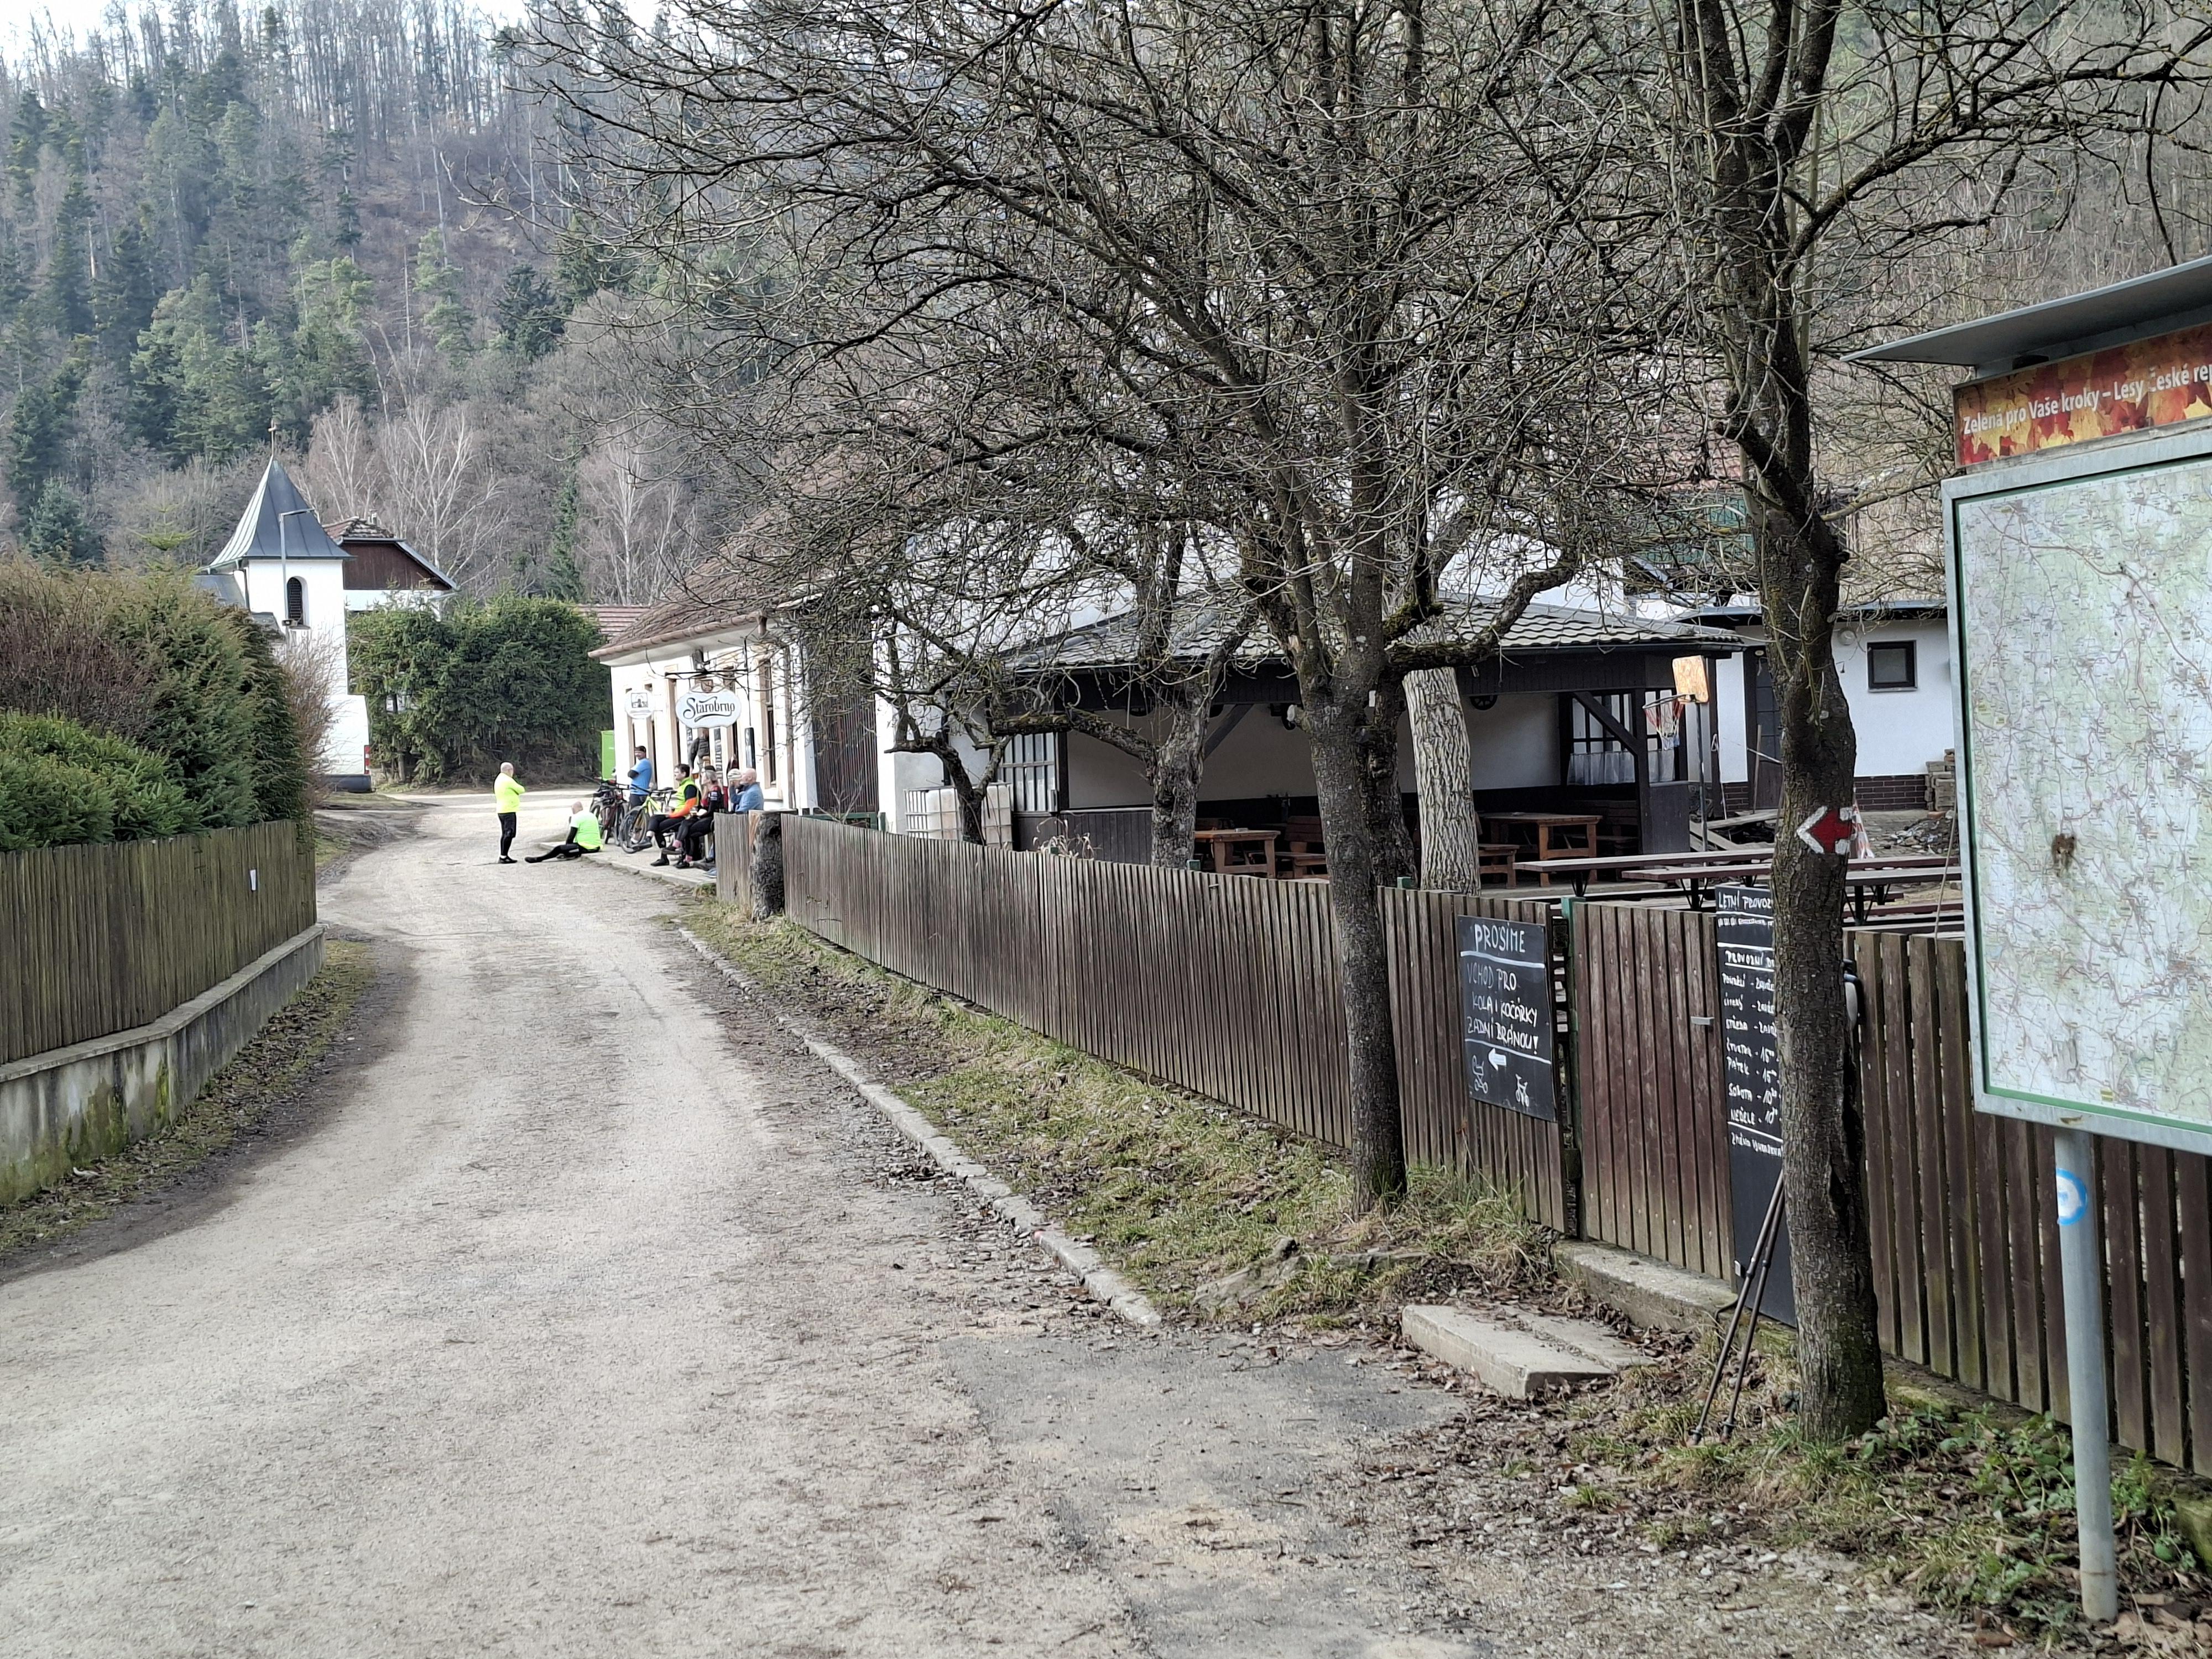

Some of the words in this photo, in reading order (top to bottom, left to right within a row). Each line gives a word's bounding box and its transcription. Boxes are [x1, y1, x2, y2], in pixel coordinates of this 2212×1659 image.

[1964, 408, 2002, 434] Zelená
[2006, 407, 2027, 431] pro
[2028, 397, 2058, 419] Vaše
[2061, 387, 2099, 411] kroky
[2114, 380, 2145, 403] Lesy
[683, 696, 735, 722] Starobrno
[1474, 922, 1526, 952] PROSÍME
[1467, 962, 1494, 989] VCHOD
[1496, 968, 1516, 991] PRO
[1472, 991, 1493, 1014] KOLA
[1467, 1016, 1494, 1039] ZADNÍ
